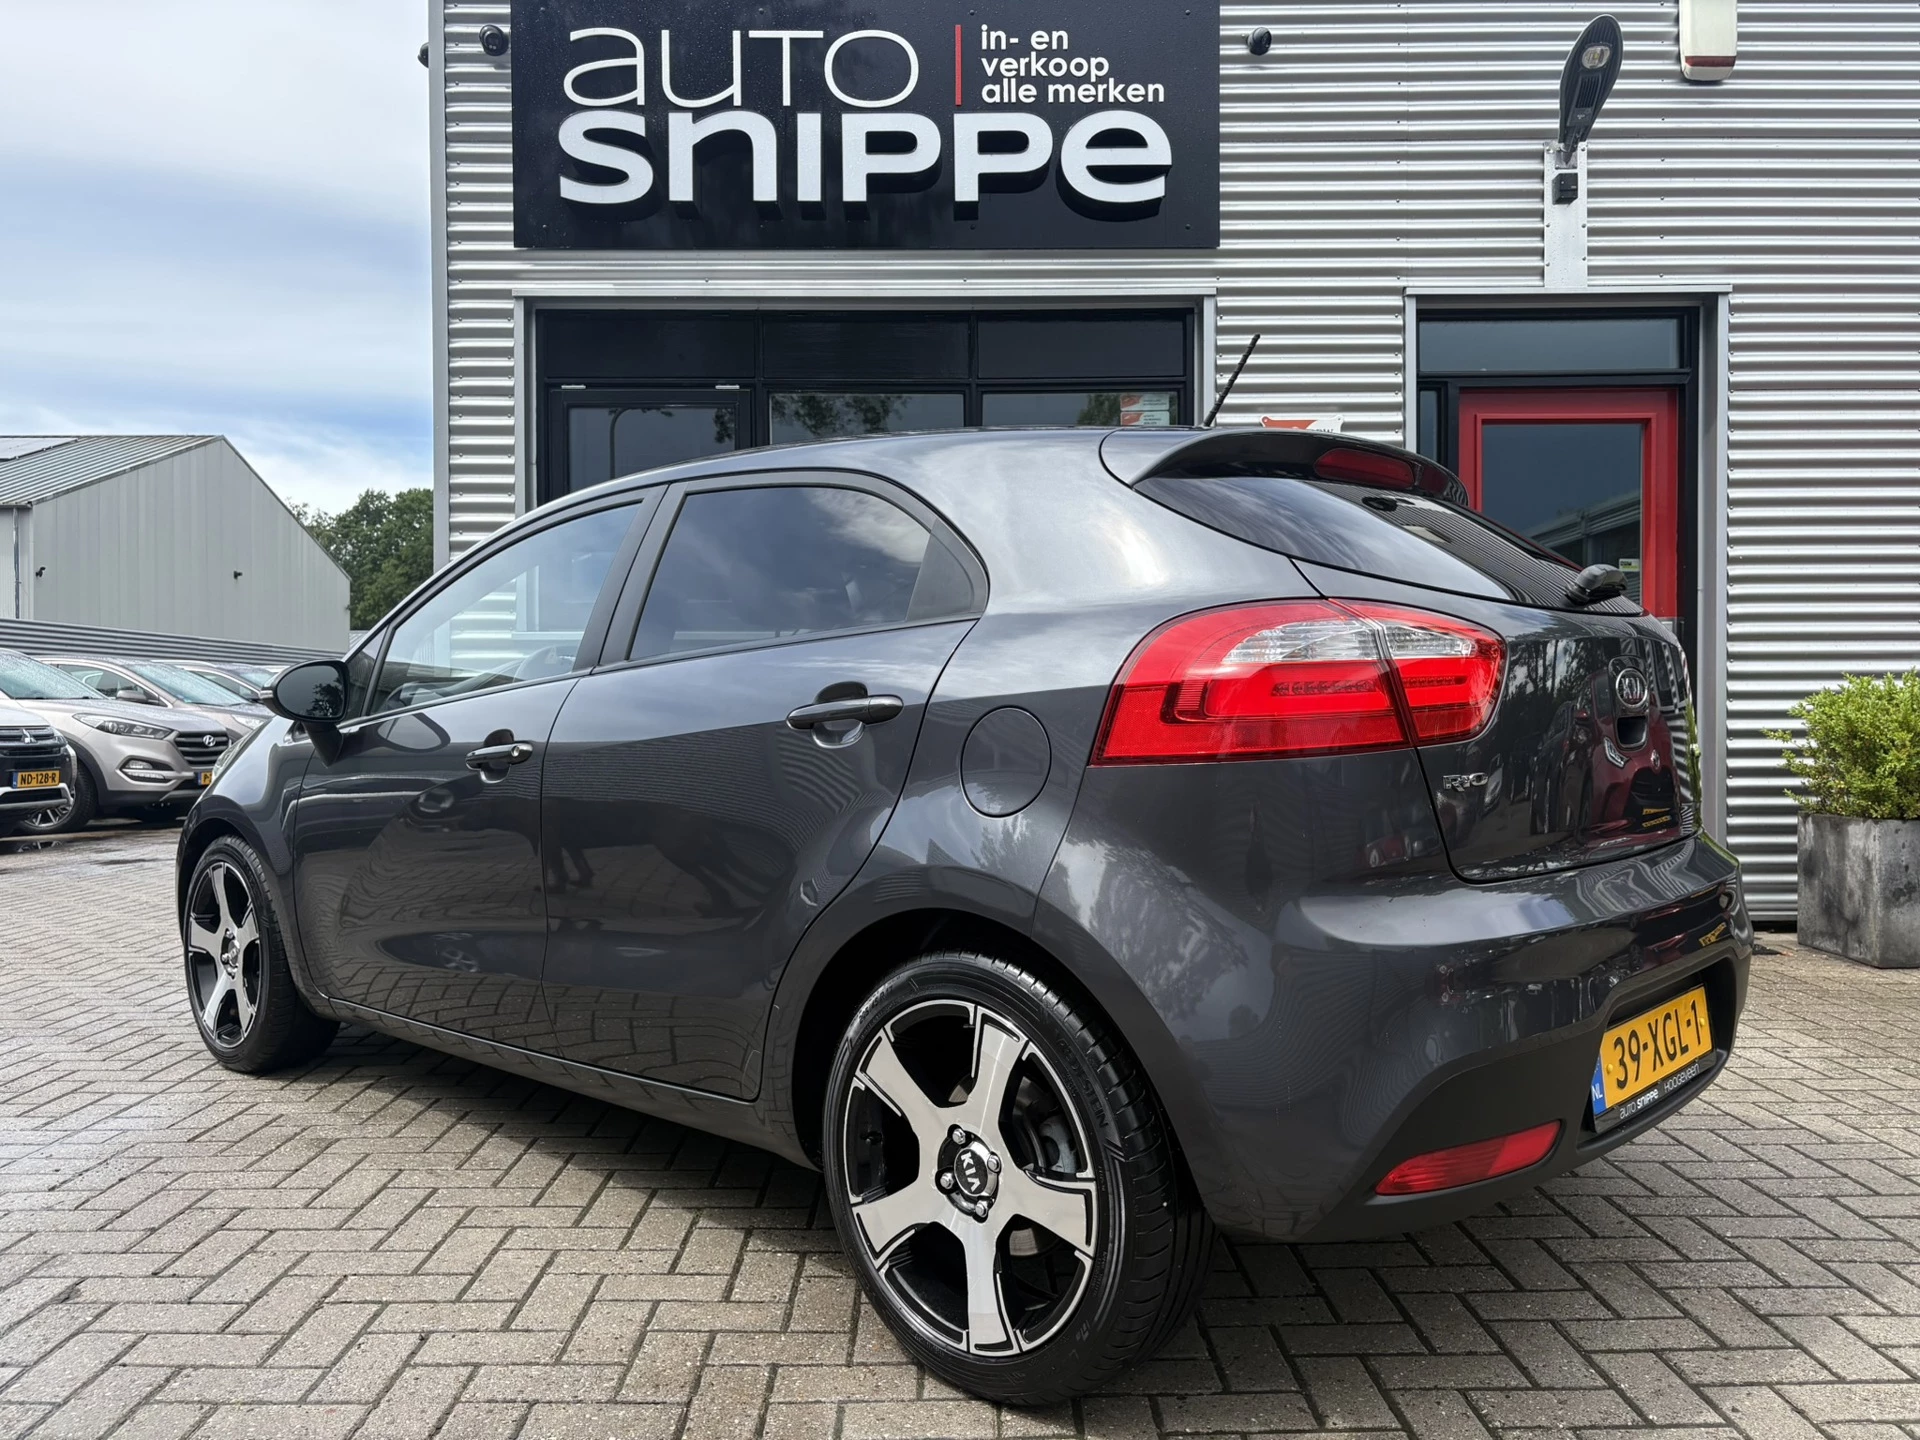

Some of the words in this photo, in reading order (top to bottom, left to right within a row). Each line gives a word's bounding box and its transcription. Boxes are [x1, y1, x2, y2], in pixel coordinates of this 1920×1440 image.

[981, 24, 1019, 50] in-
[1031, 30, 1069, 50] en
[981, 51, 1110, 82] verkoop
[981, 78, 1037, 103] alle
[1048, 78, 1165, 103] merken
[20, 772, 56, 785] ND-128-R
[1613, 1000, 1701, 1090] 39-XGL-1
[1591, 1082, 1604, 1102] NL
[960, 1151, 981, 1193] KIA
